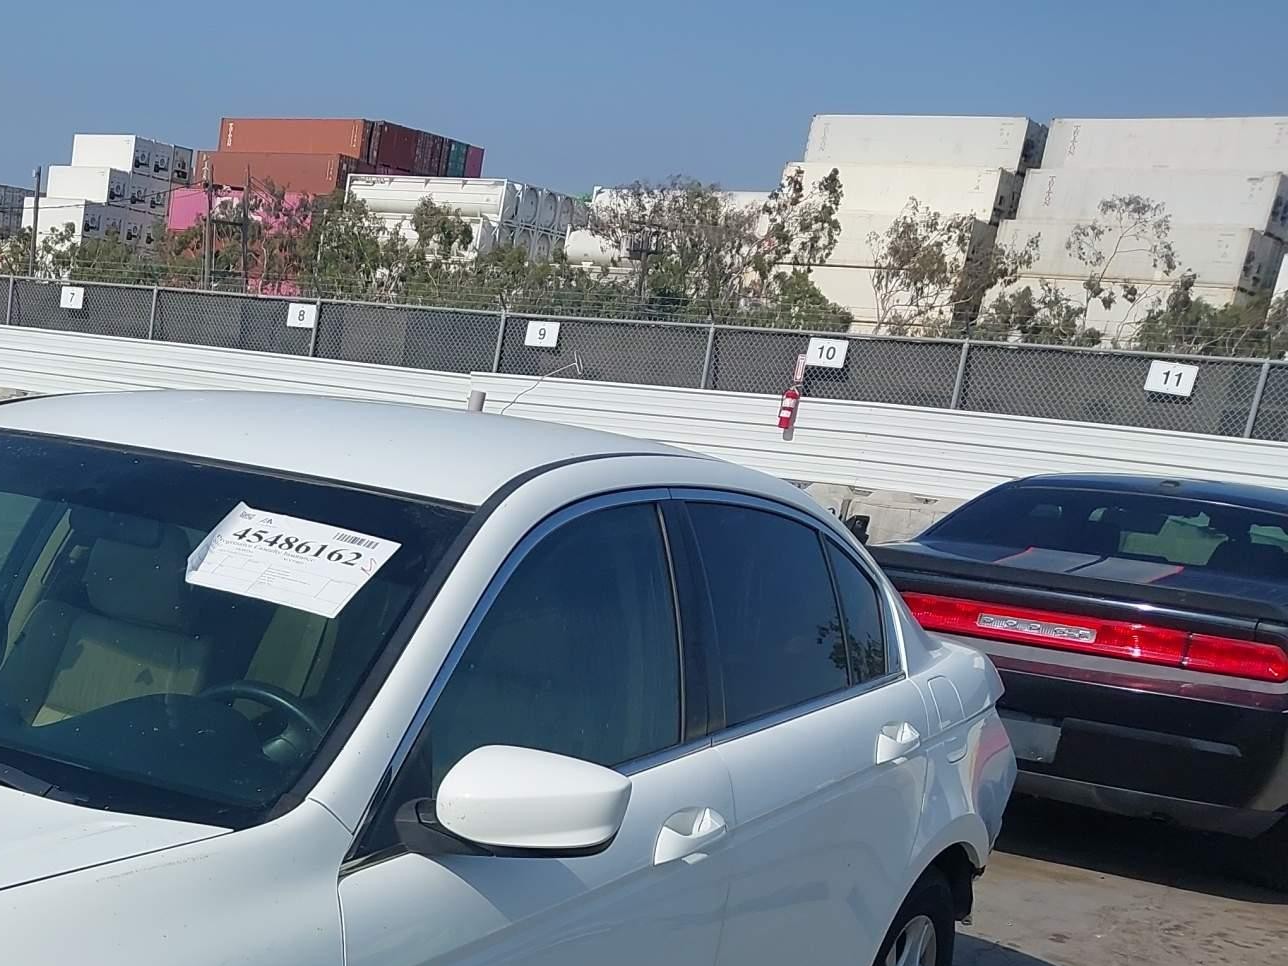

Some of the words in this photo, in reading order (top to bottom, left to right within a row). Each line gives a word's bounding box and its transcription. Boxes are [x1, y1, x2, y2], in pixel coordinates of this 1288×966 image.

[69, 292, 76, 303] 7
[298, 309, 305, 321] 8
[538, 327, 547, 340] 9
[817, 345, 837, 361] 10
[1162, 370, 1184, 387] 11
[232, 527, 363, 567] 45486162
